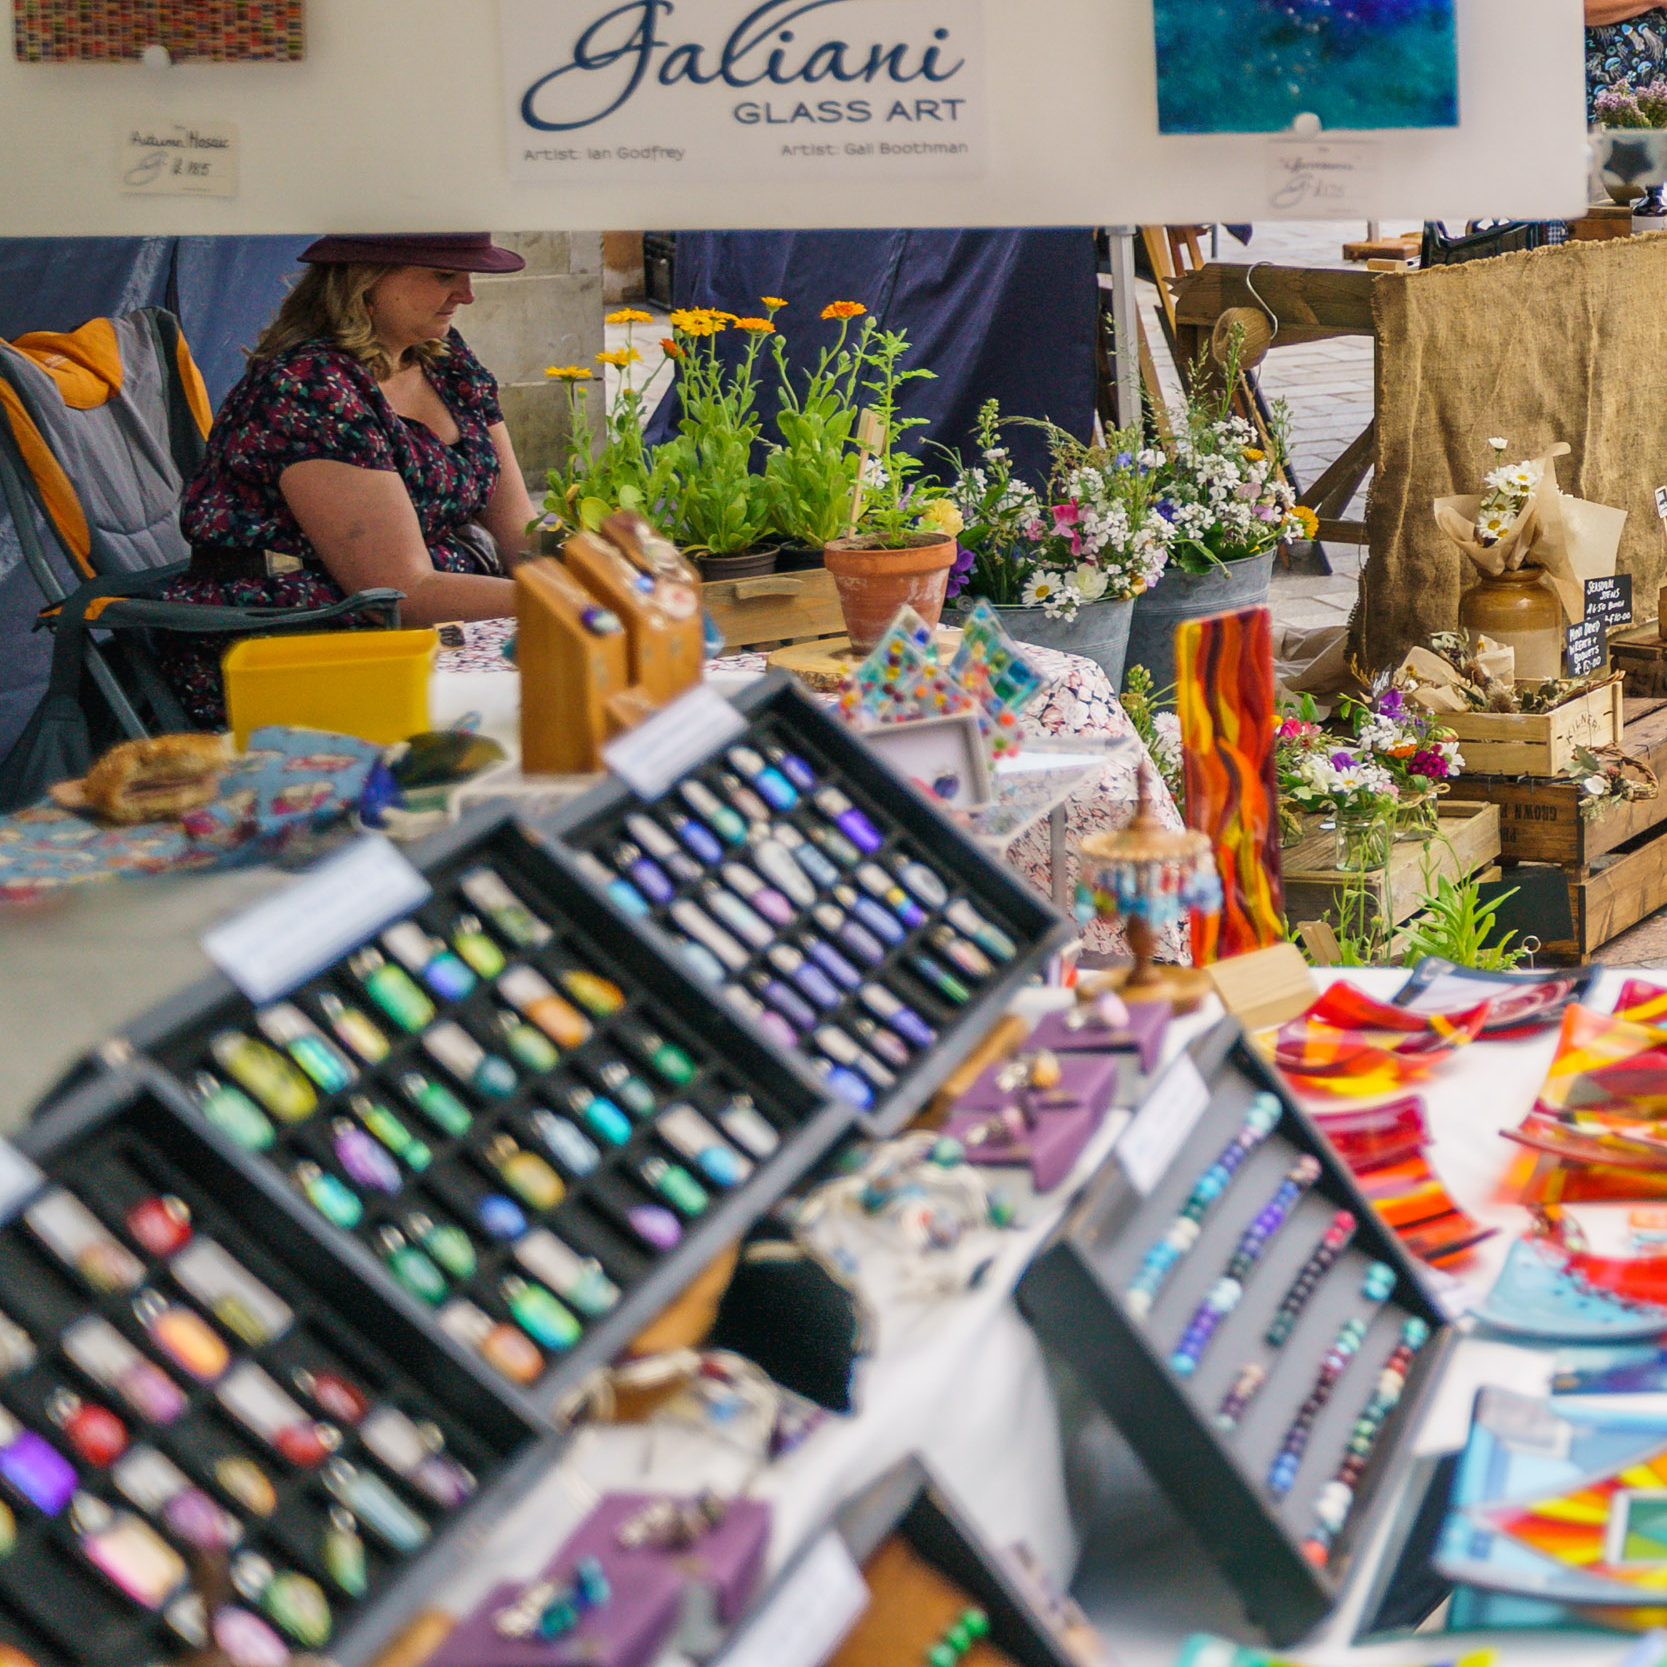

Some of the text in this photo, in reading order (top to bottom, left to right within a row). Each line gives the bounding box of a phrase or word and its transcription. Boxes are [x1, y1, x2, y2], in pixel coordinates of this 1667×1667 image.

[734, 98, 966, 124] GLASS ART
[587, 147, 611, 160] Ian
[616, 145, 686, 162] Godfrey
[880, 140, 968, 156] Boothman
[1566, 713, 1599, 745] KILNER
